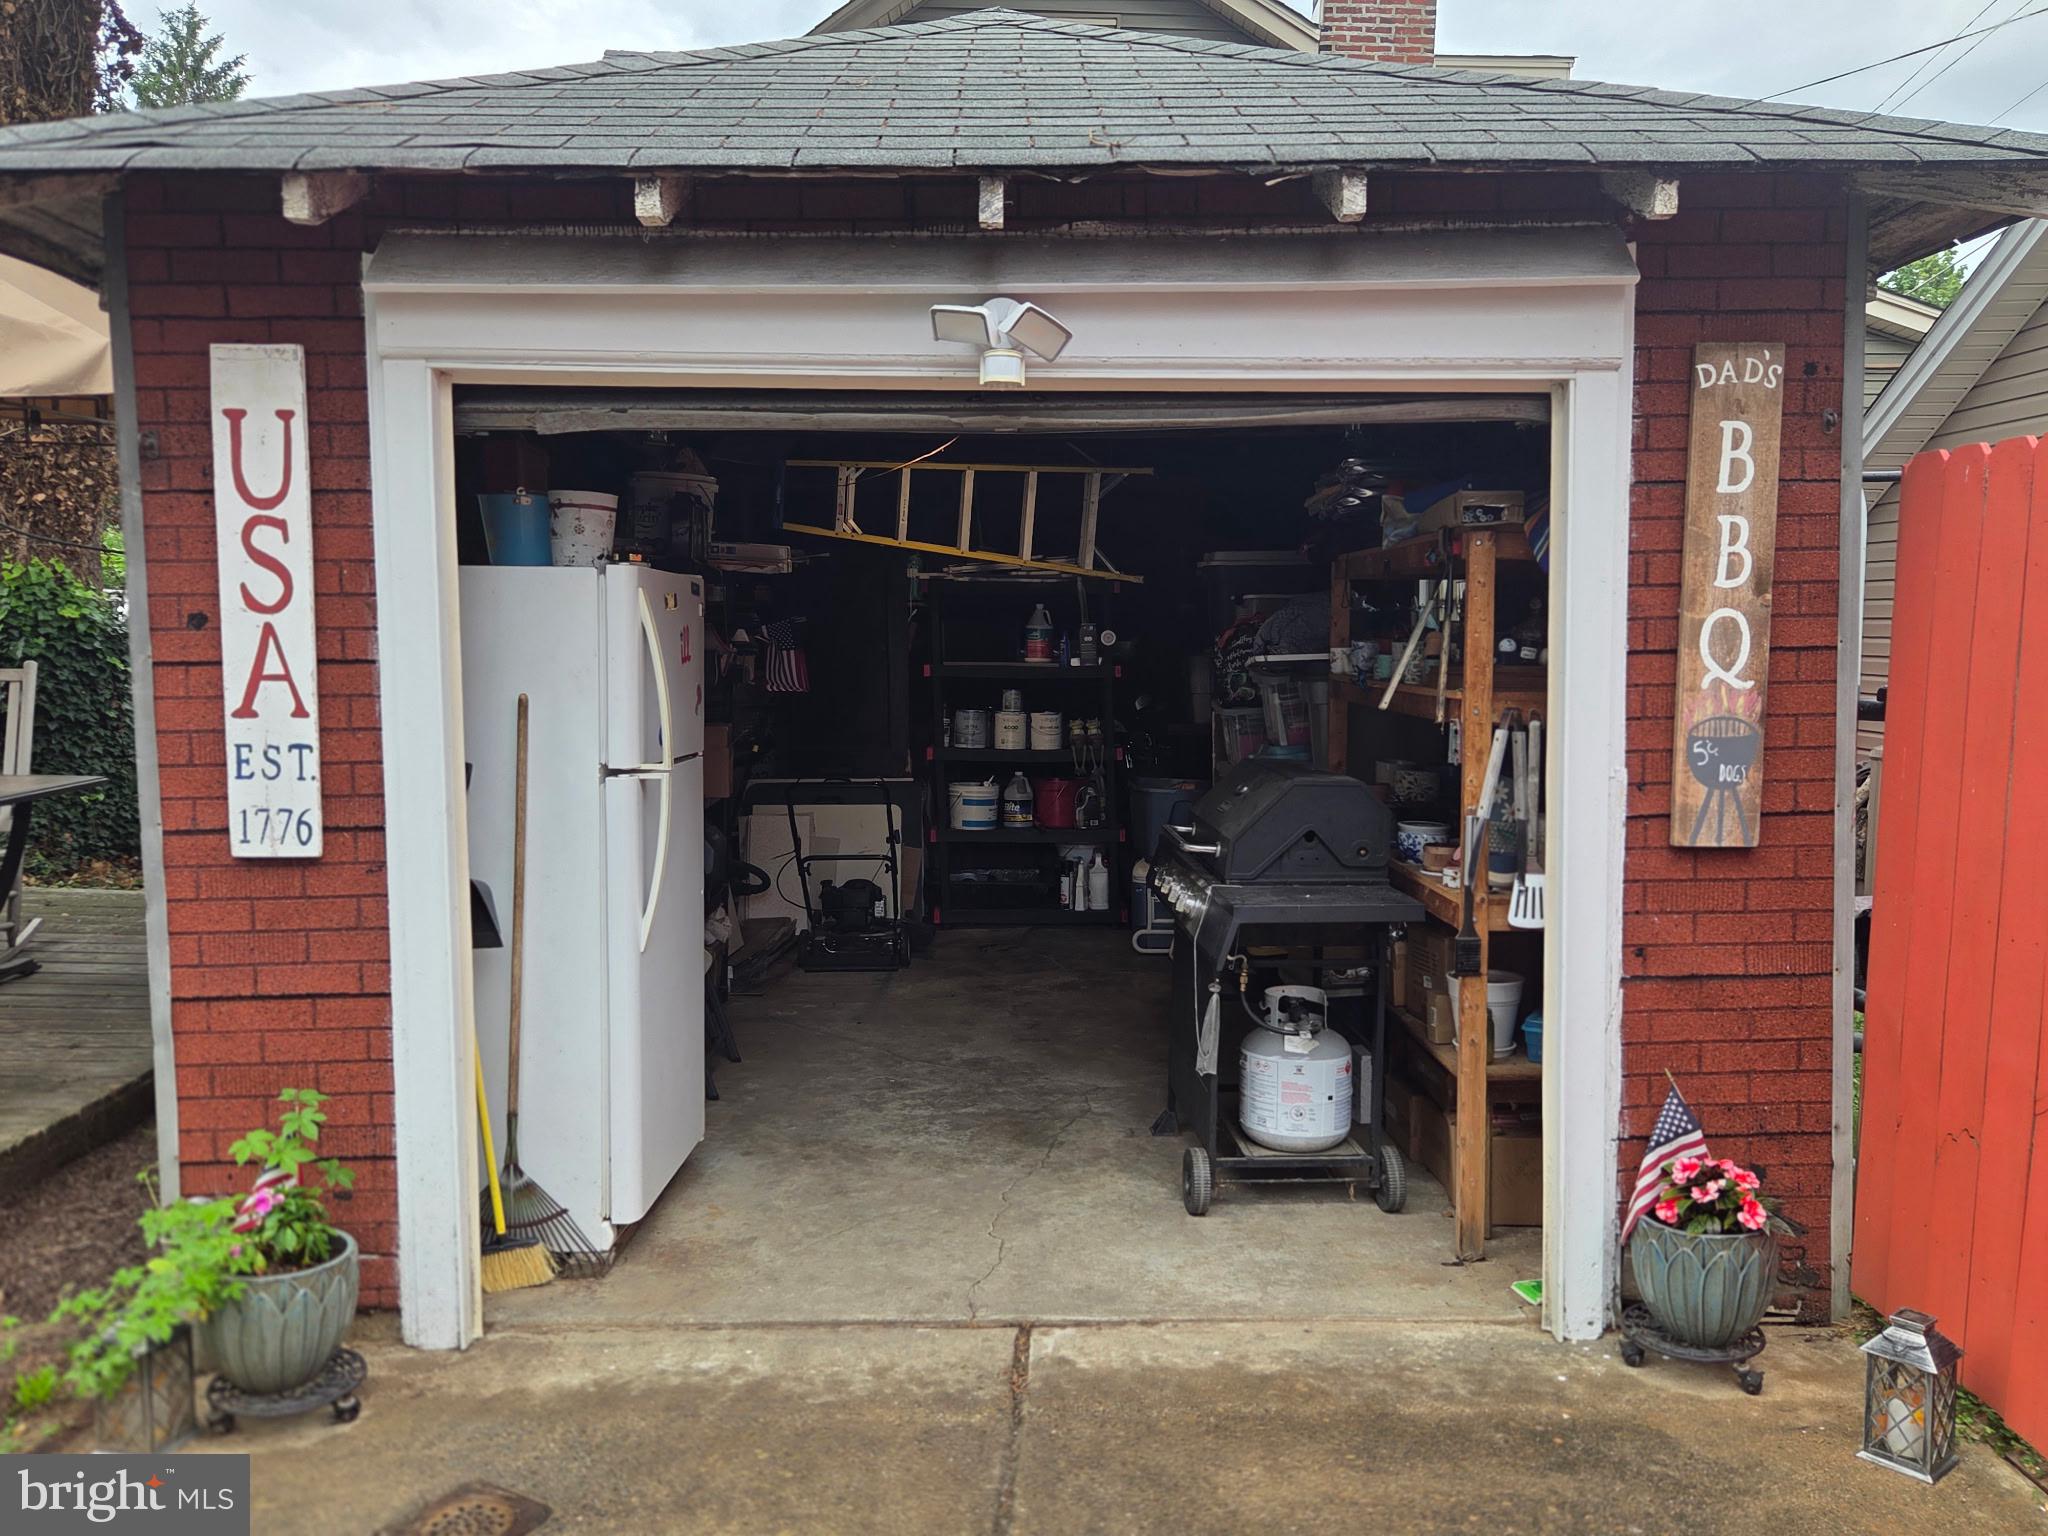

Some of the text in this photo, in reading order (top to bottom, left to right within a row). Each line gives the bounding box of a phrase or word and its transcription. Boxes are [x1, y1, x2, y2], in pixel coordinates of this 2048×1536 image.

[1695, 350, 1783, 391] DAD'S
[221, 408, 311, 719] USA
[1699, 419, 1756, 690] BBQ
[233, 742, 317, 782] EST.
[1718, 764, 1747, 784] DOGS
[238, 807, 313, 847] 1776
